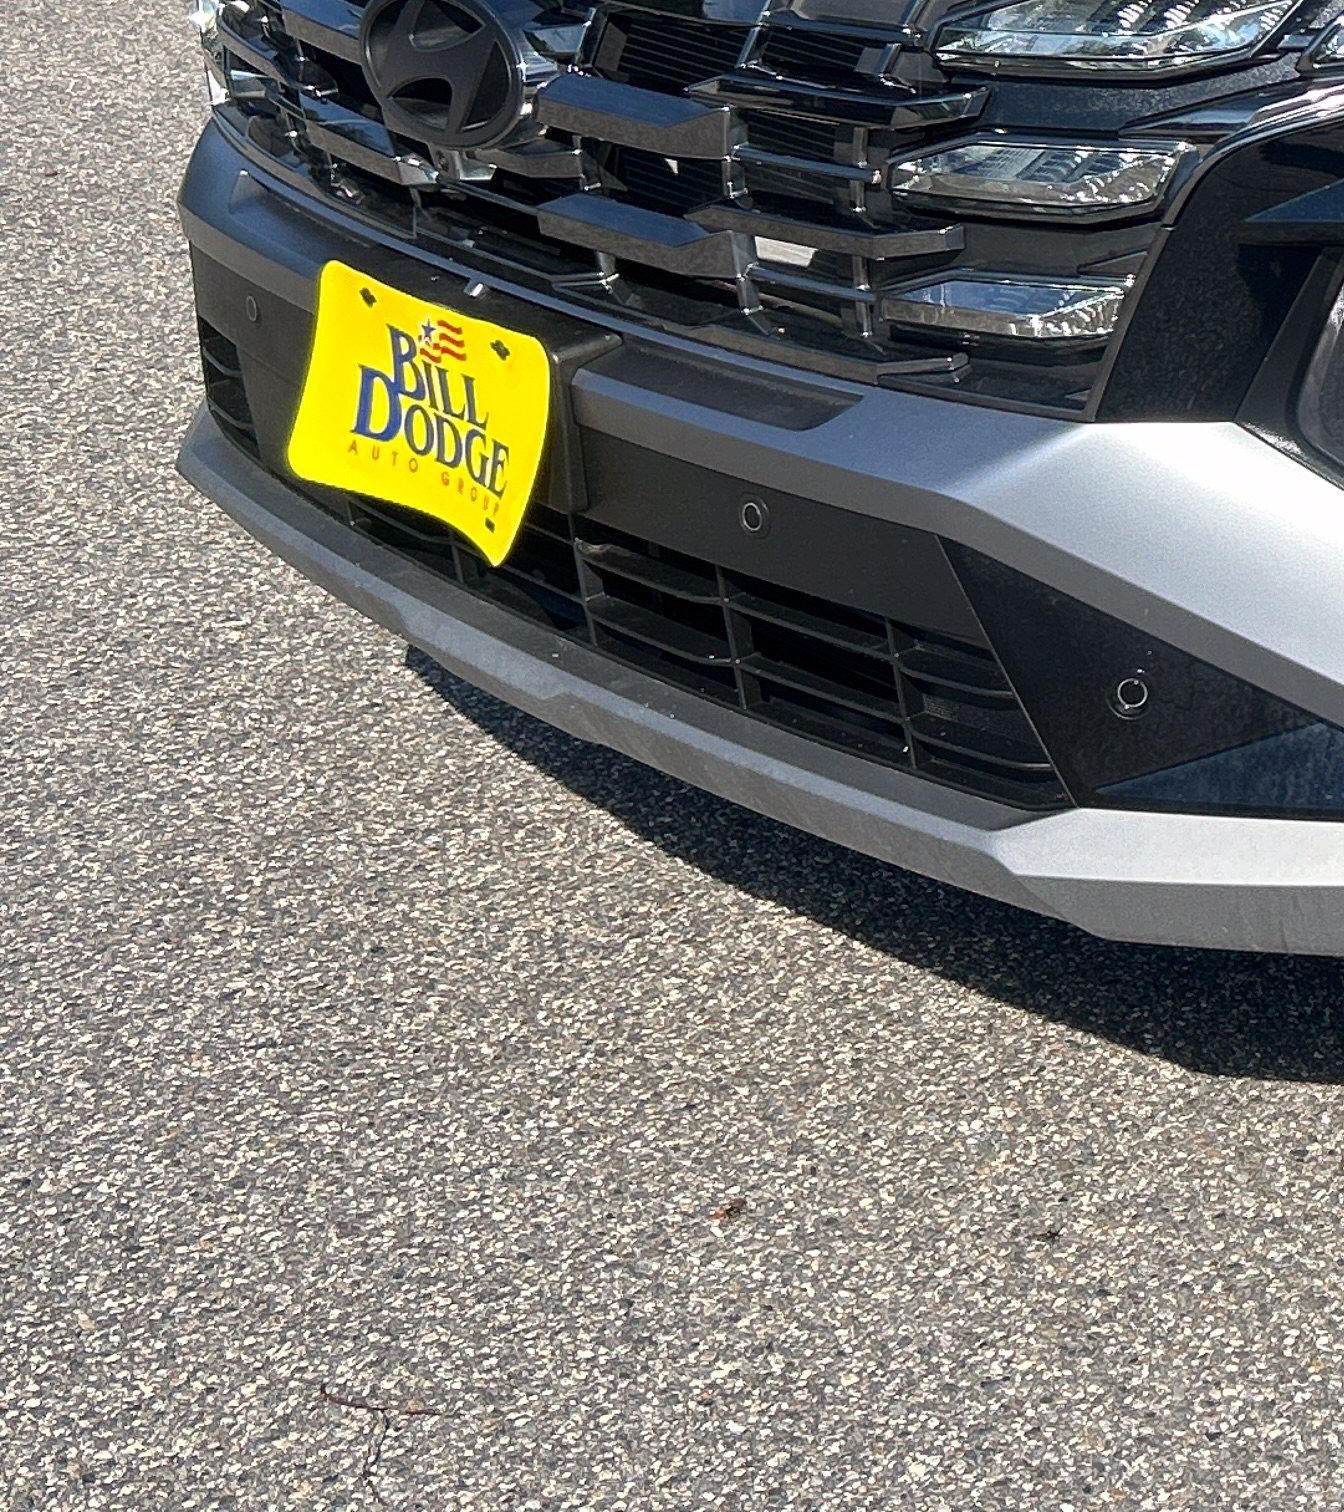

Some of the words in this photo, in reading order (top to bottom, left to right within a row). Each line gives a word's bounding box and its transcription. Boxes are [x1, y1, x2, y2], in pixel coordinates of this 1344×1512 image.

[387, 323, 490, 429] BILL
[348, 439, 419, 472] AUTO
[441, 471, 500, 516] GROUP
[350, 364, 509, 497] DODGE
